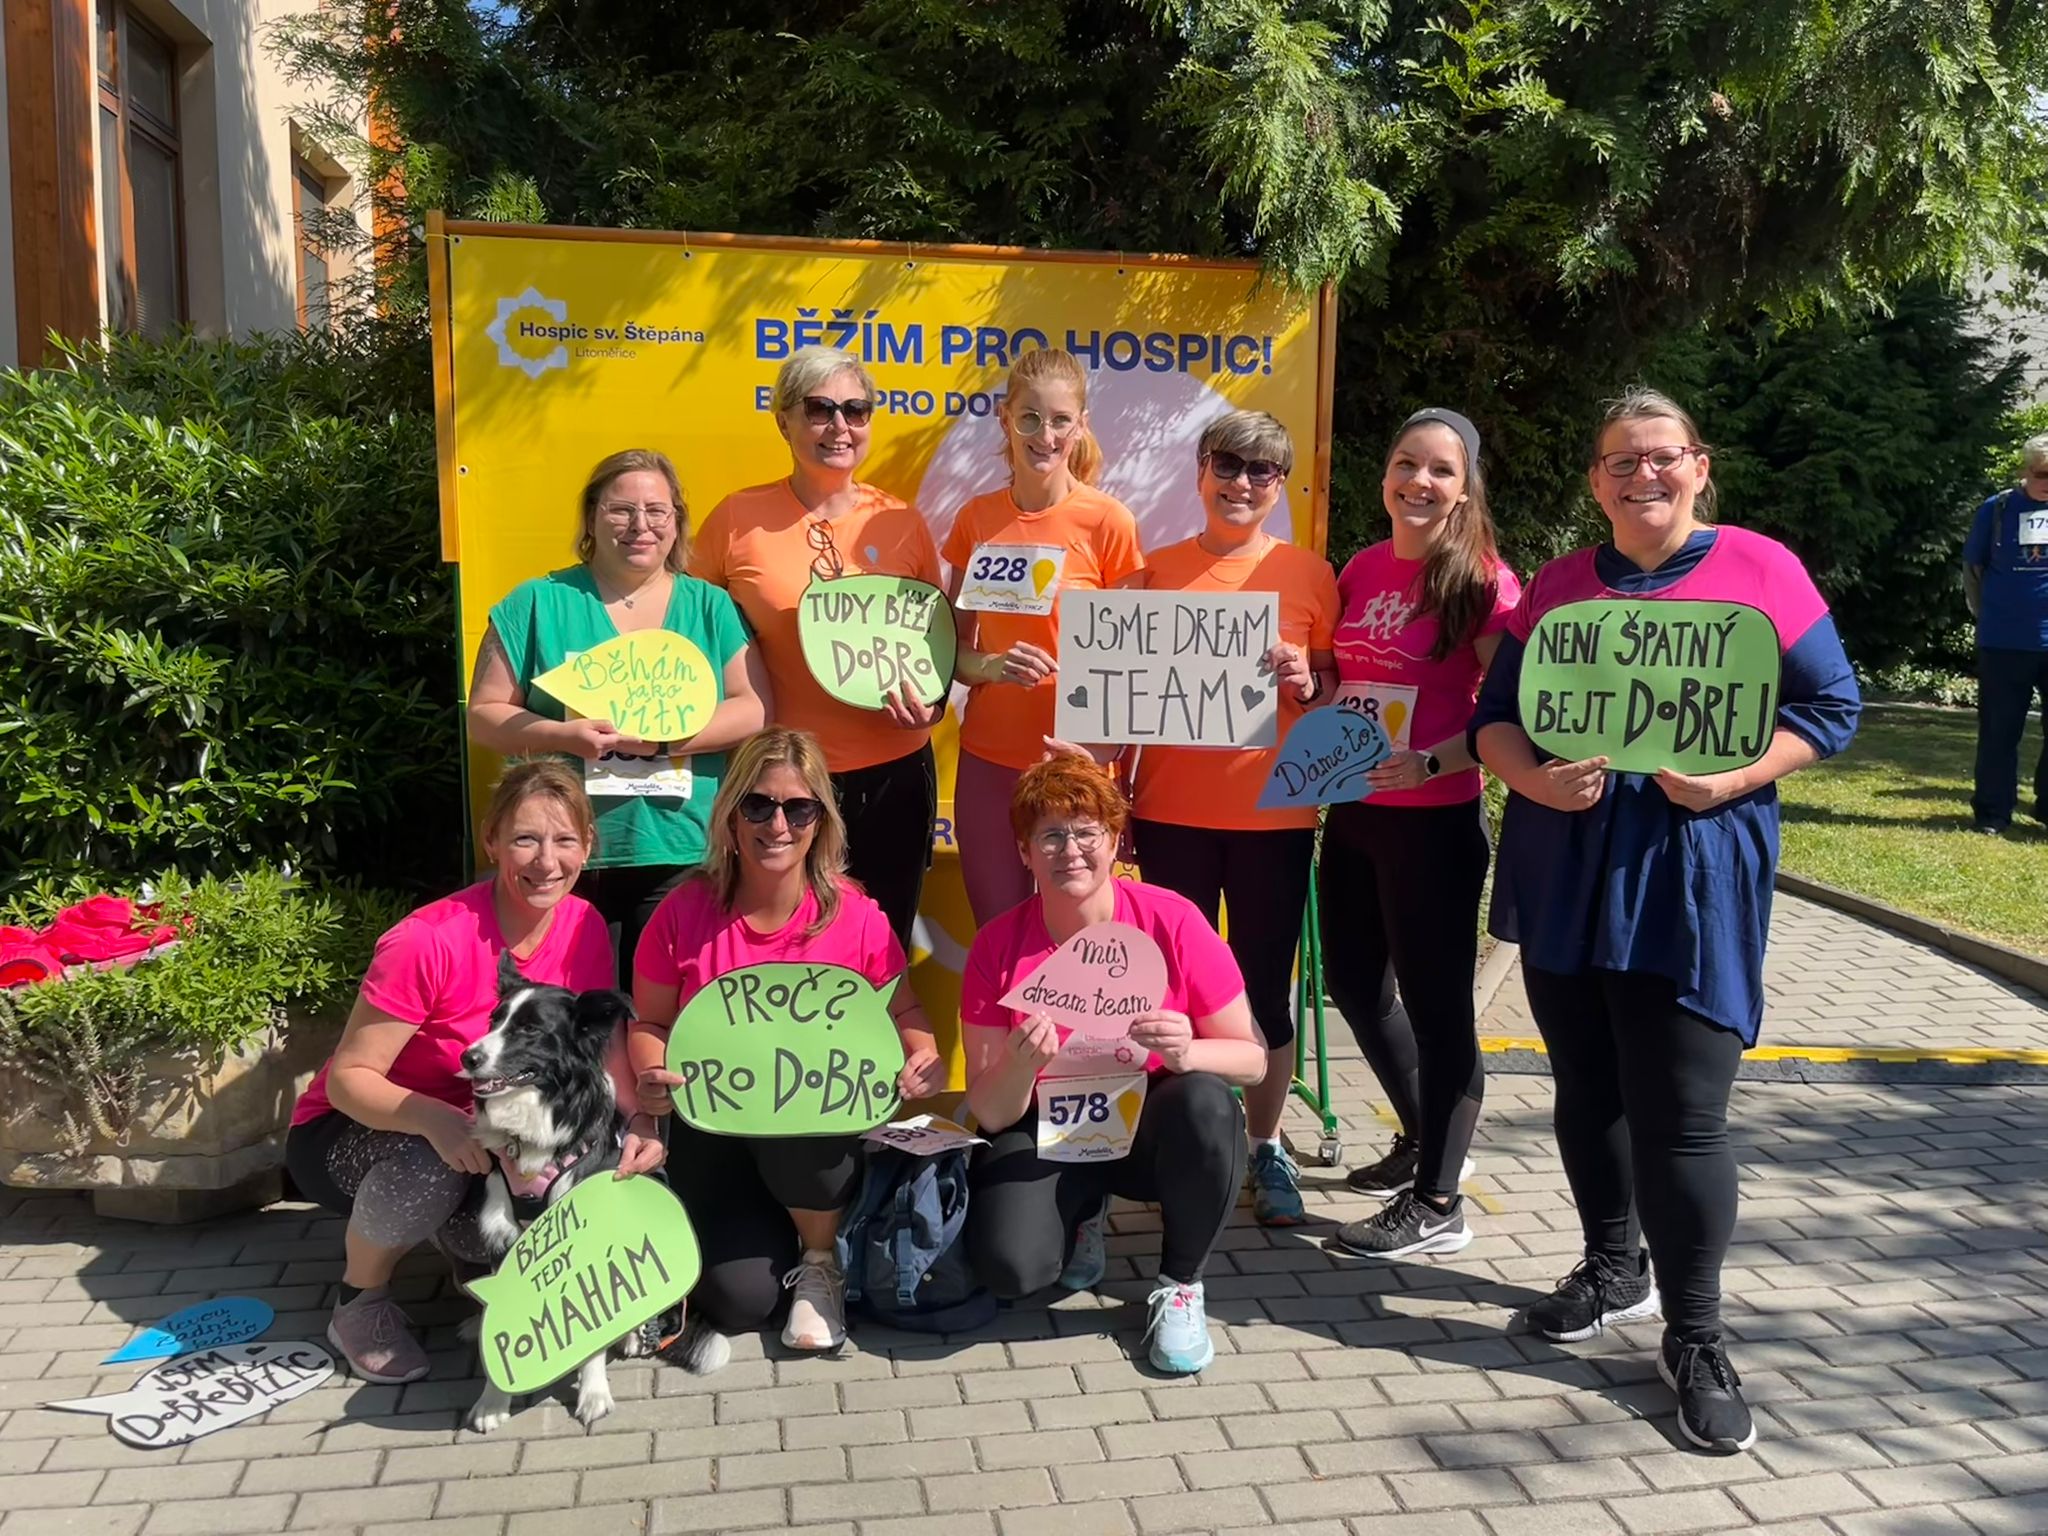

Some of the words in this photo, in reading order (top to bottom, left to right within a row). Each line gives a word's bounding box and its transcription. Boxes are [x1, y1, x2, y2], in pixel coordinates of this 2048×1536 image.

[520, 321, 588, 341] Hospic
[594, 327, 619, 340] sv.
[625, 321, 704, 344] Štěpána
[575, 347, 636, 359] Litoměřice
[755, 307, 922, 364] BĚŽÍM
[1065, 330, 1272, 375] HOSPIC!
[2026, 516, 2048, 529] 17
[973, 556, 1028, 582] 328
[807, 592, 876, 624] TUDY
[885, 588, 941, 634] BĚŽÍ
[1073, 602, 1159, 656] JSME
[1173, 603, 1270, 658] DREAM
[1538, 610, 1612, 664] NENÍ
[1613, 610, 1741, 668] ŠPATNÝ
[573, 640, 697, 691] Běhám
[625, 679, 682, 708] jako
[1088, 665, 1235, 743] TEAM
[1534, 690, 1616, 735] BEJT
[1273, 746, 1349, 797] Dáme
[1022, 974, 1087, 1014] dream
[1093, 986, 1152, 1017] team
[1048, 1091, 1110, 1126] 578
[882, 1126, 939, 1143] 581
[515, 1198, 588, 1276] BĚŽÍM,
[531, 1244, 574, 1292] TEDY
[151, 1349, 242, 1392] JSEM
